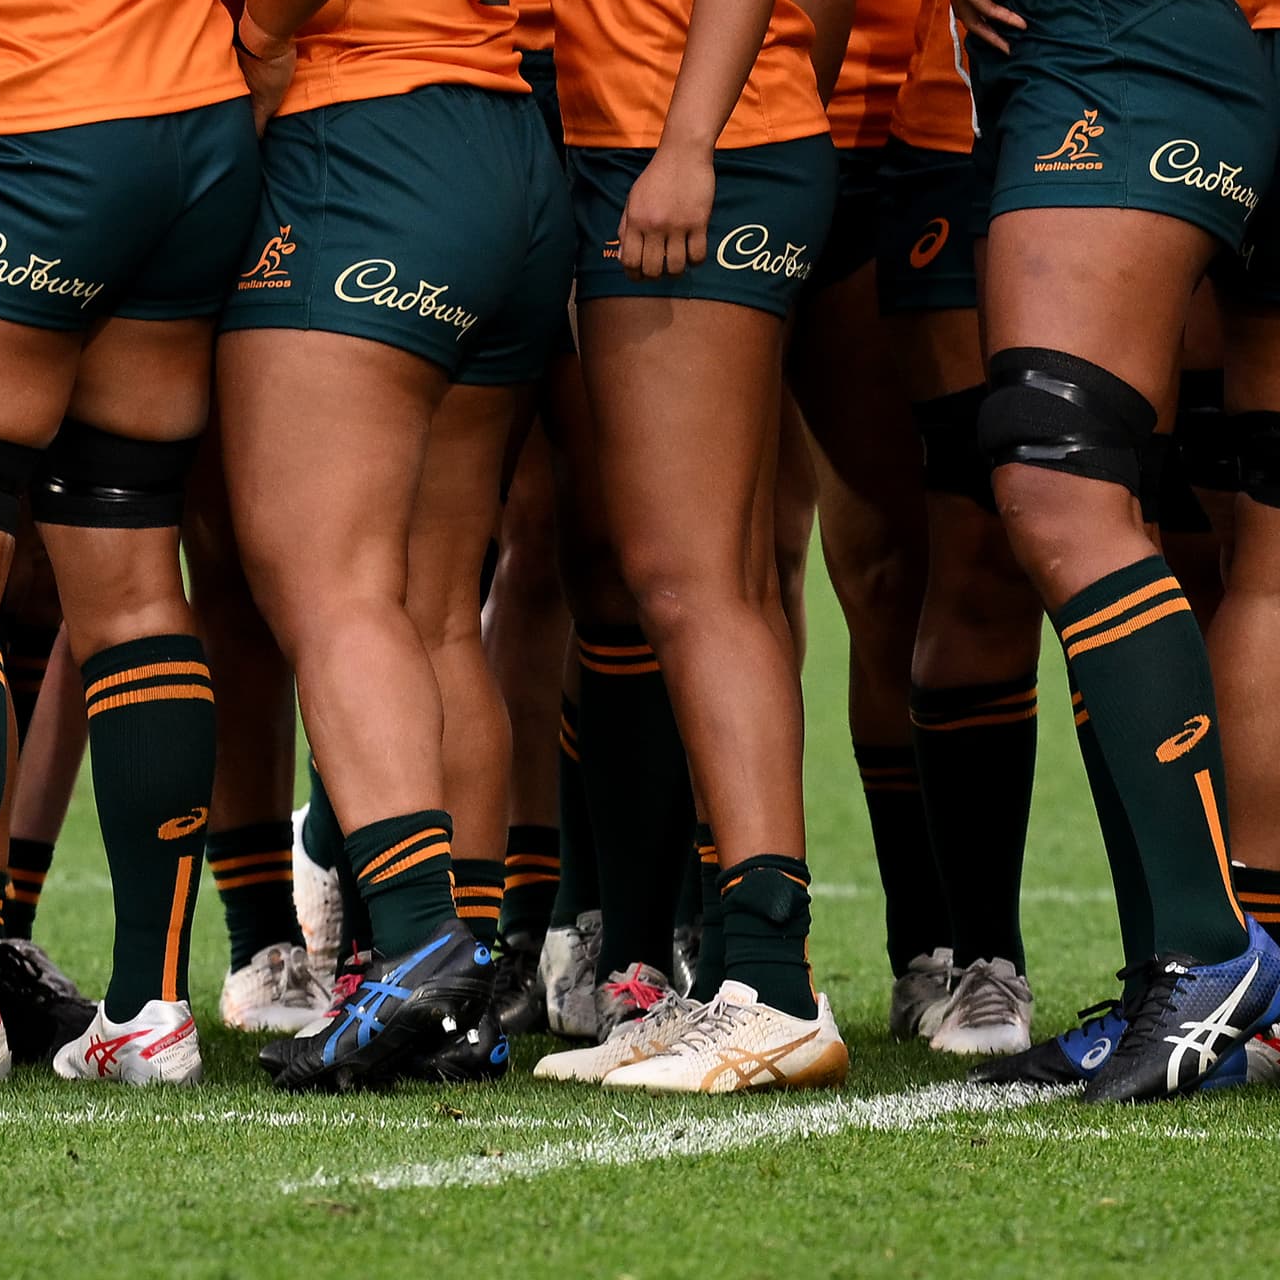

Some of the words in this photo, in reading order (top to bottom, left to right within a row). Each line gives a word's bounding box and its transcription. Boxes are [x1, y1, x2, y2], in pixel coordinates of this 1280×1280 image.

[1034, 161, 1104, 172] Wallaroos
[1149, 138, 1259, 222] Cadbury
[334, 258, 479, 342] Cadbury
